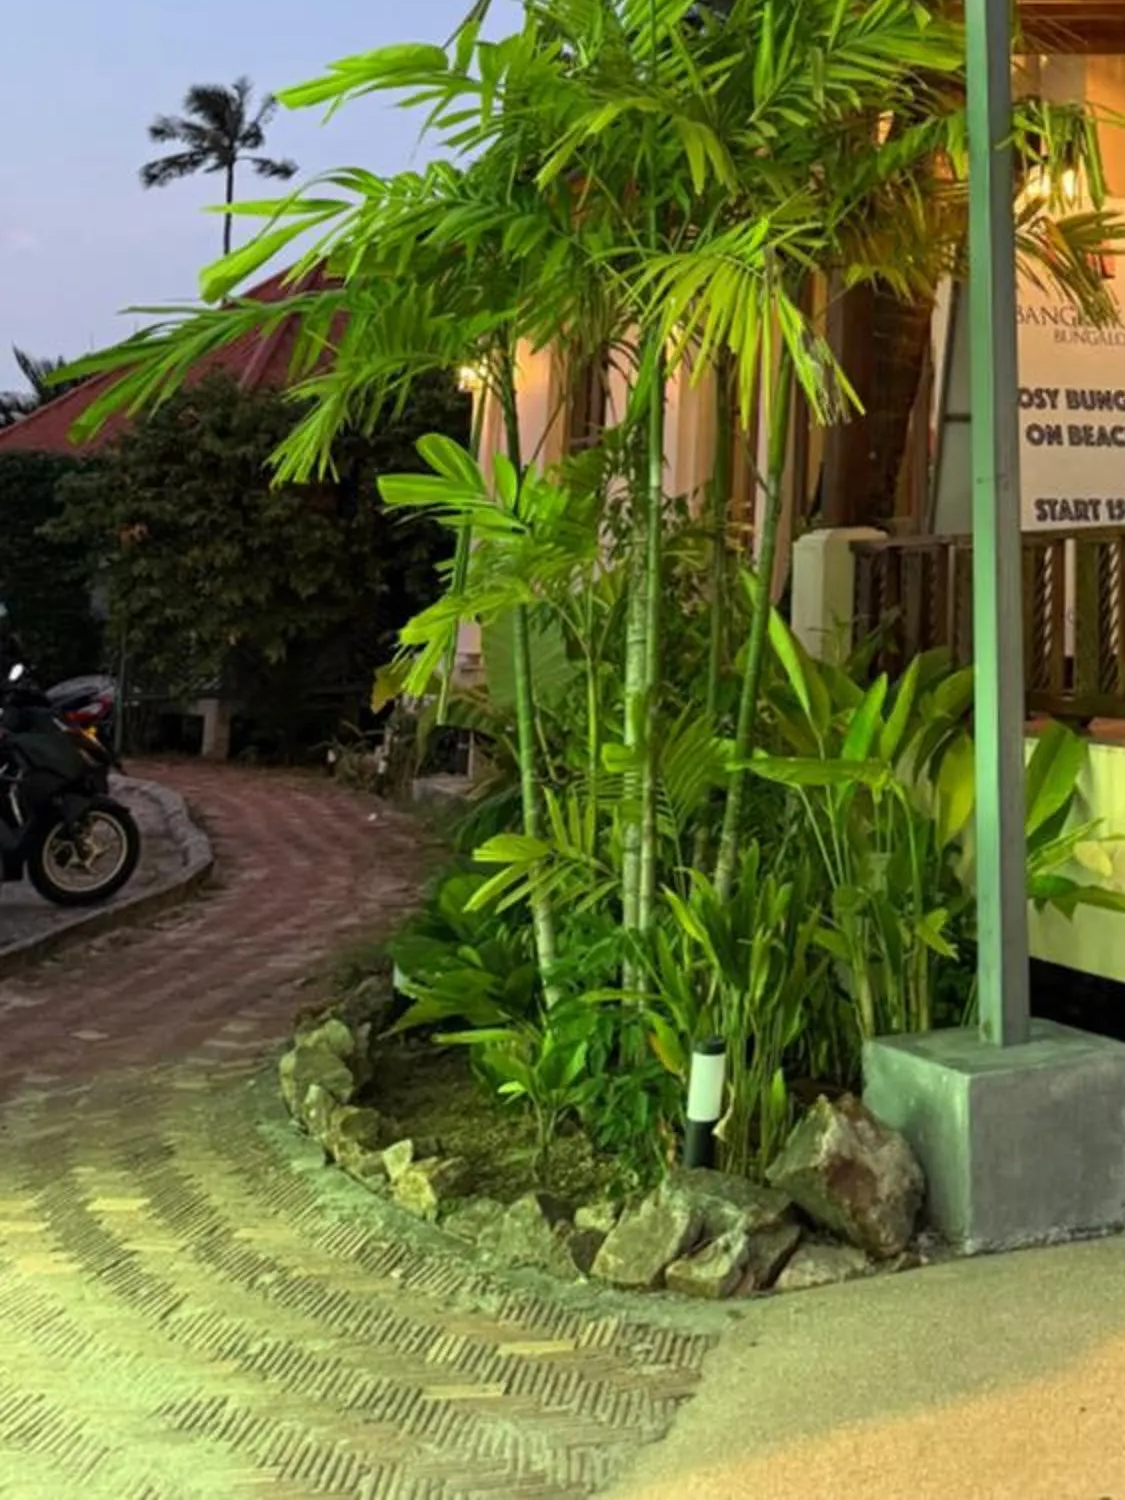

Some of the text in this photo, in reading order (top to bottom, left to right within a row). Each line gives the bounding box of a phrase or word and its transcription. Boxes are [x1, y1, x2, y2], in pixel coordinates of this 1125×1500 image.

[1019, 388, 1060, 410] OSY
[1026, 423, 1063, 446] ON
[1035, 498, 1101, 522] START
